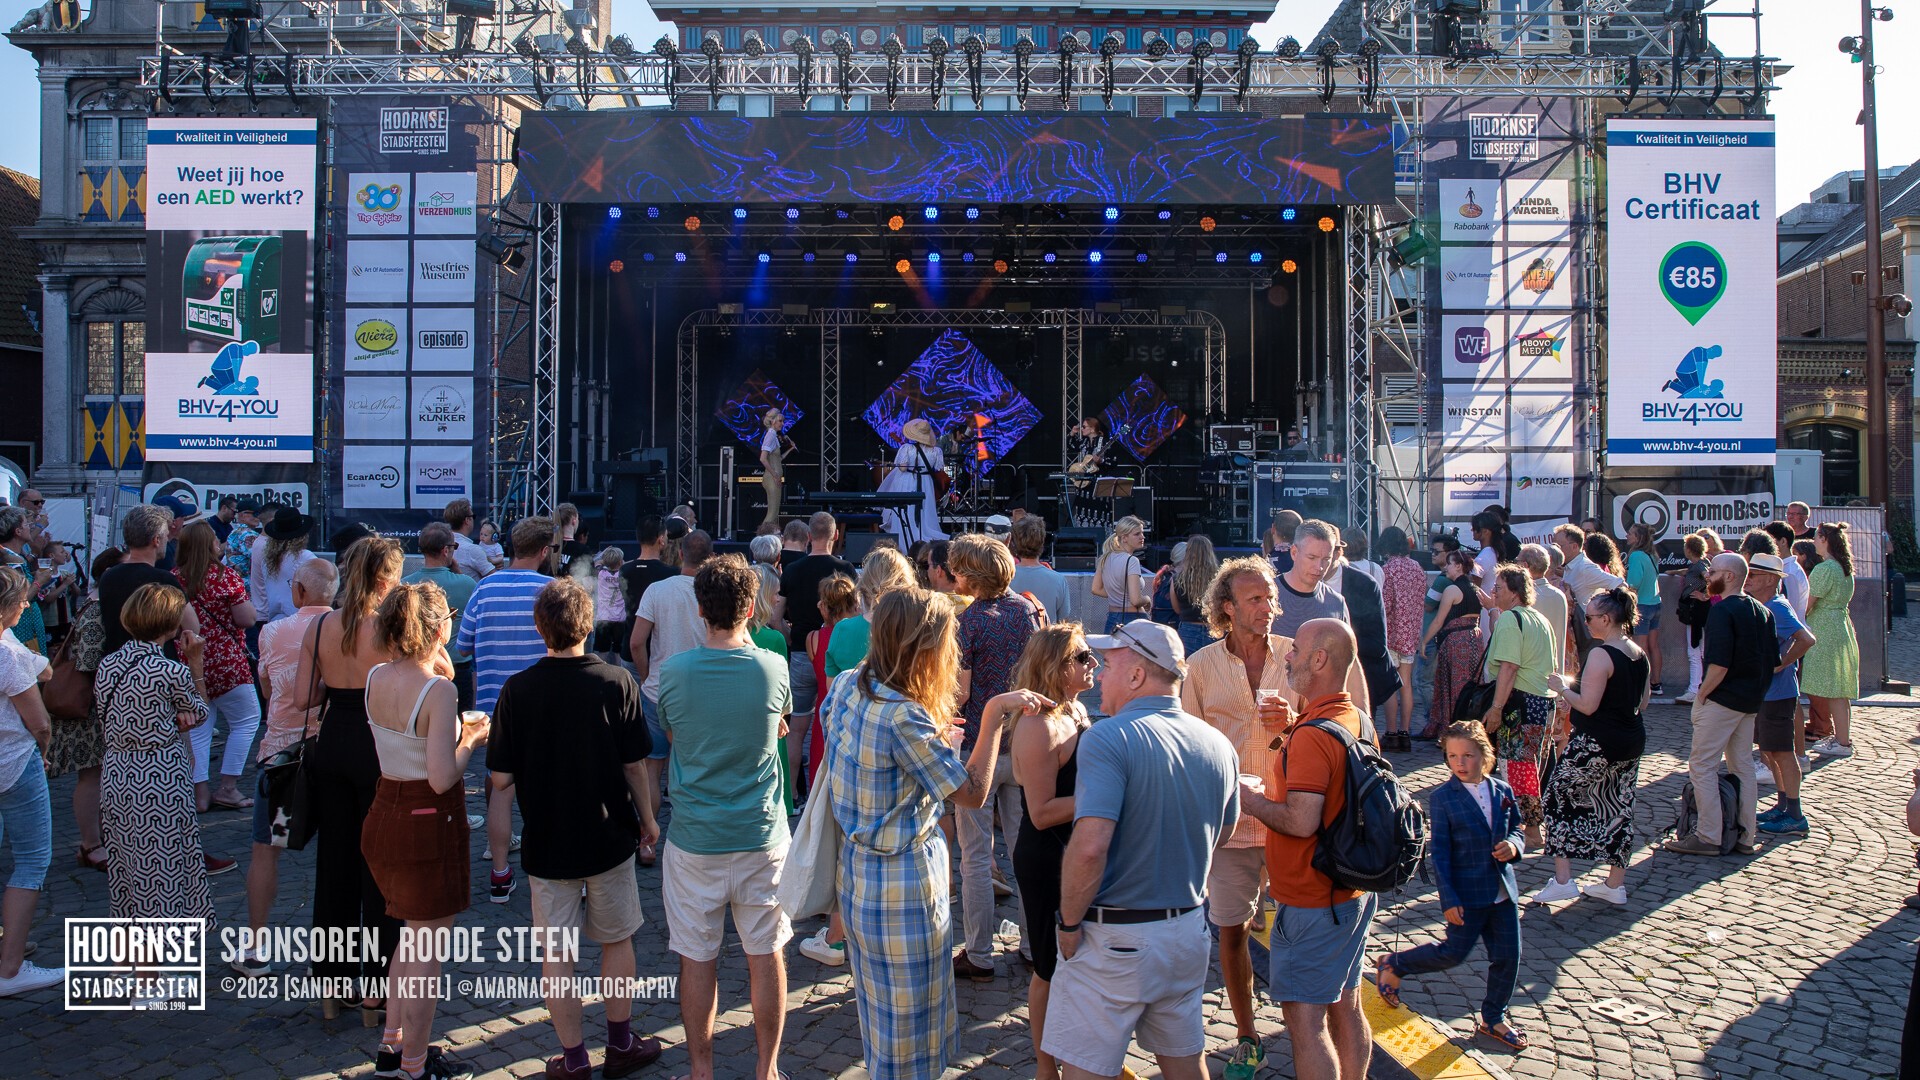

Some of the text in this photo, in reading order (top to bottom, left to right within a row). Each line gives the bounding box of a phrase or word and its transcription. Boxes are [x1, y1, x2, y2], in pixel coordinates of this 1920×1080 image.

[384, 112, 445, 129] HOORNSE
[1473, 118, 1535, 136] HOORNSE
[176, 132, 287, 144] Kwaliteit in Veiligheid
[383, 136, 445, 148] STADSFEESTEN
[1636, 134, 1748, 146] Kwaliteit in Veiligheid
[1473, 143, 1535, 155] STADSFEESTEN
[177, 167, 284, 186] Weet jij hoe
[1664, 173, 1721, 194] BHV
[157, 190, 304, 205] een AED werkt?
[1520, 198, 1552, 206] LINDA
[418, 208, 472, 216] VERZENDHUIS
[1513, 207, 1559, 215] WAGNER
[1626, 198, 1760, 220] Certificaat
[357, 213, 371, 223] The
[1454, 223, 1490, 231] Rabobank
[420, 262, 469, 273] Westfries
[420, 272, 466, 280] Museum
[1669, 266, 1716, 289] €85
[424, 332, 463, 348] episode
[1459, 334, 1487, 356] WF
[178, 399, 279, 423] BHV-4-YOU
[1448, 408, 1501, 416] WINSTON
[1642, 402, 1743, 426] BHV-4-YOU
[180, 438, 277, 449] www.bhv-4-you.nl
[1643, 441, 1741, 453] www.bhv-4-you.nl
[1284, 488, 1329, 496] MIDAS
[1718, 525, 1726, 534] of
